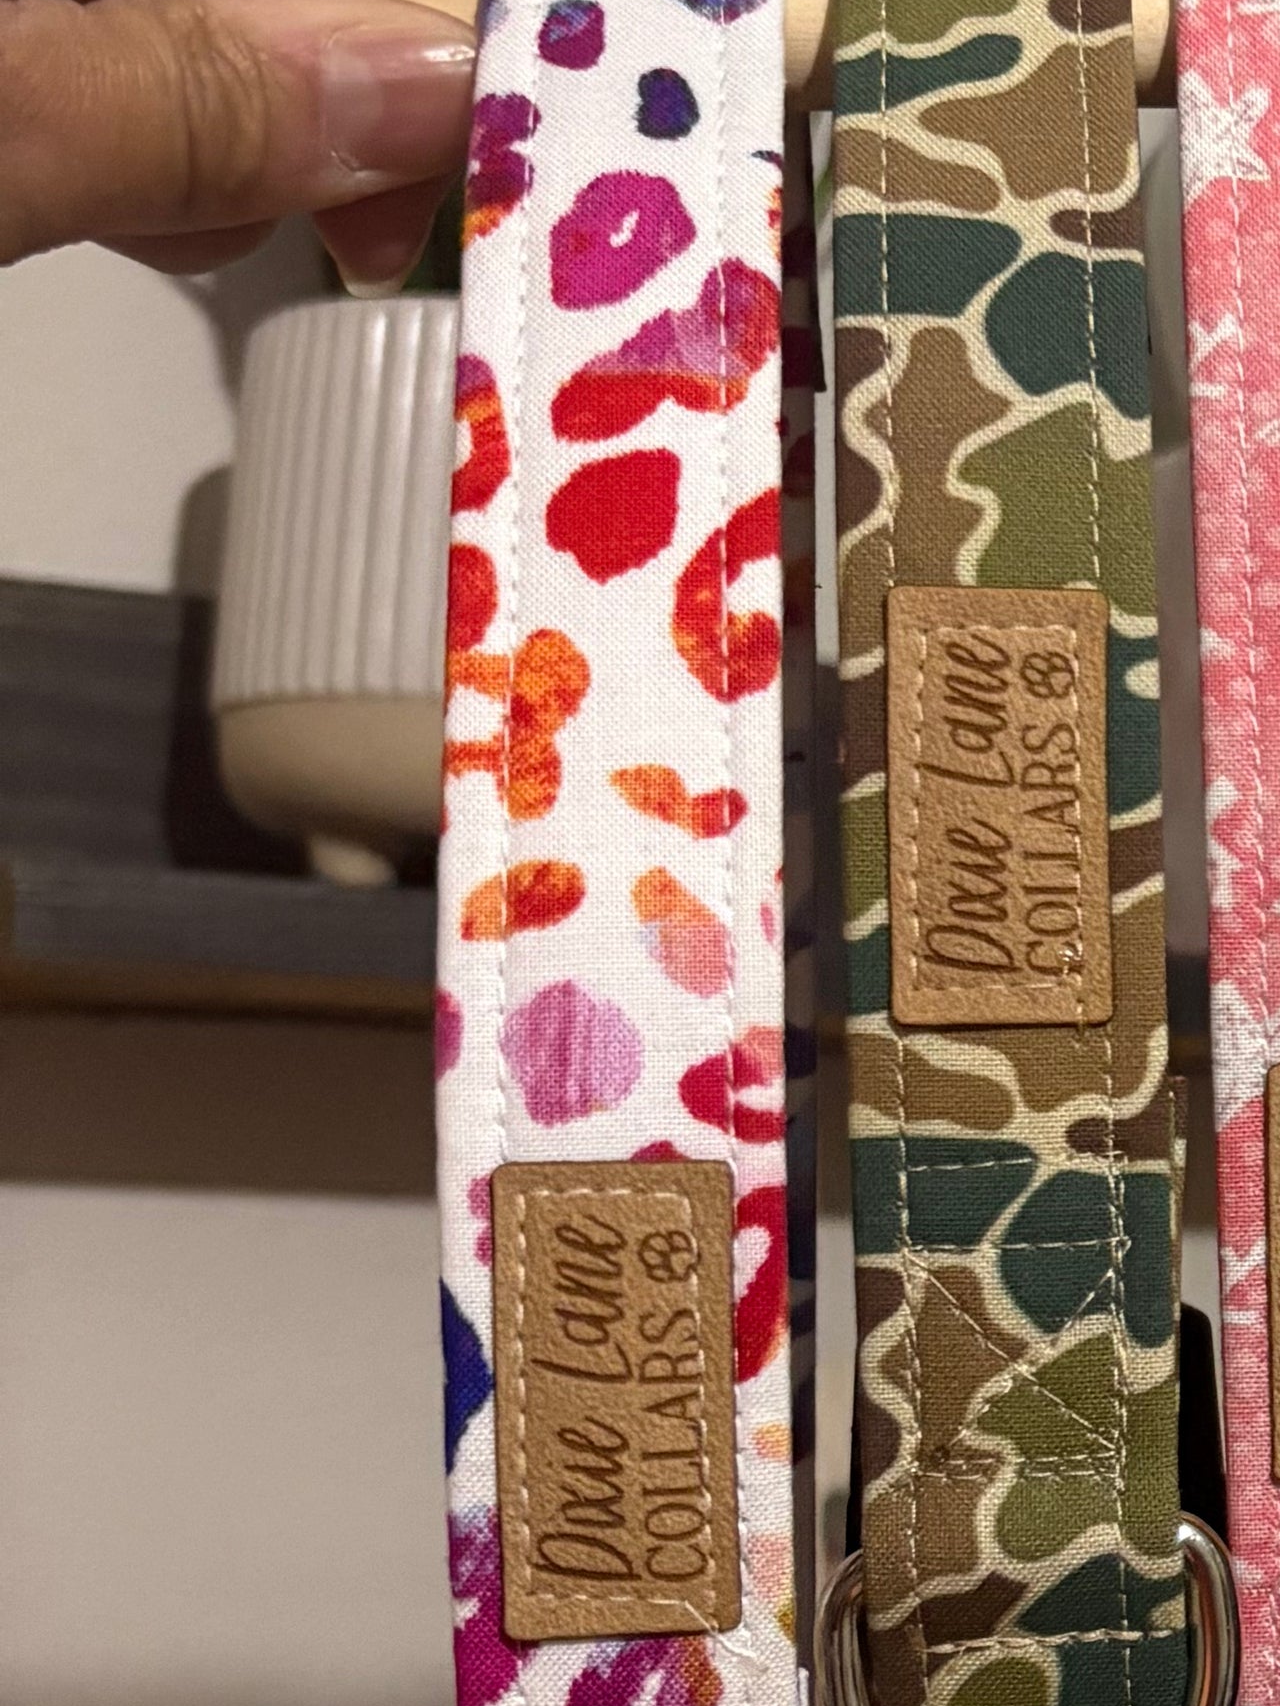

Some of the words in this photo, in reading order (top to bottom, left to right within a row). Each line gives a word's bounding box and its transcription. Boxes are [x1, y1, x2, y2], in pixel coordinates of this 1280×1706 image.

[917, 633, 1015, 789] Lane
[1021, 723, 1083, 975] COLLARS
[531, 1214, 633, 1384] Lane
[638, 1308, 708, 1582] COLLARS
